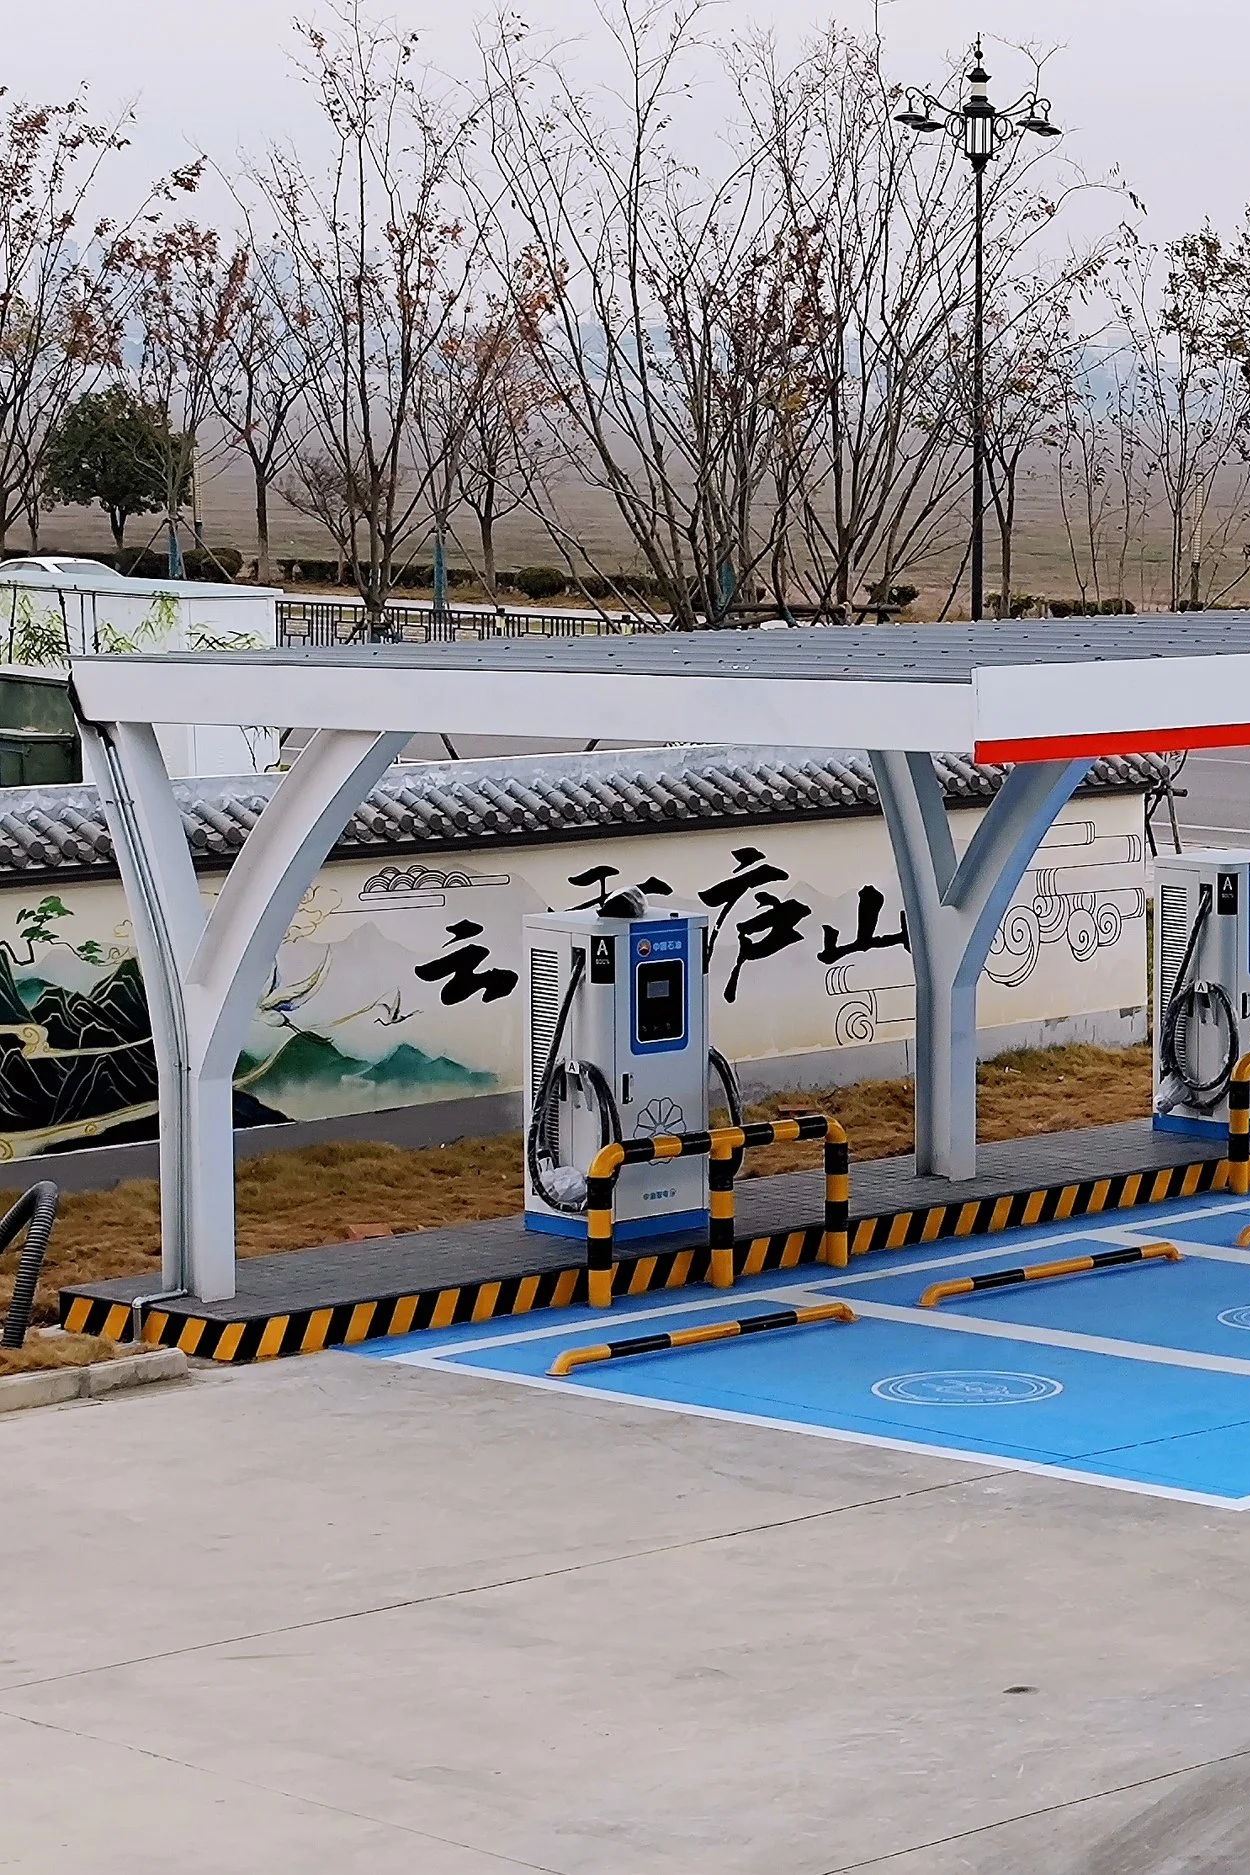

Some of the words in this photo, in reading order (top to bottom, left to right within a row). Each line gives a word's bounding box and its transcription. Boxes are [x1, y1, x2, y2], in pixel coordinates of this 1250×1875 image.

[1223, 876, 1233, 891] A
[596, 939, 609, 956] A
[568, 1062, 576, 1072] A
